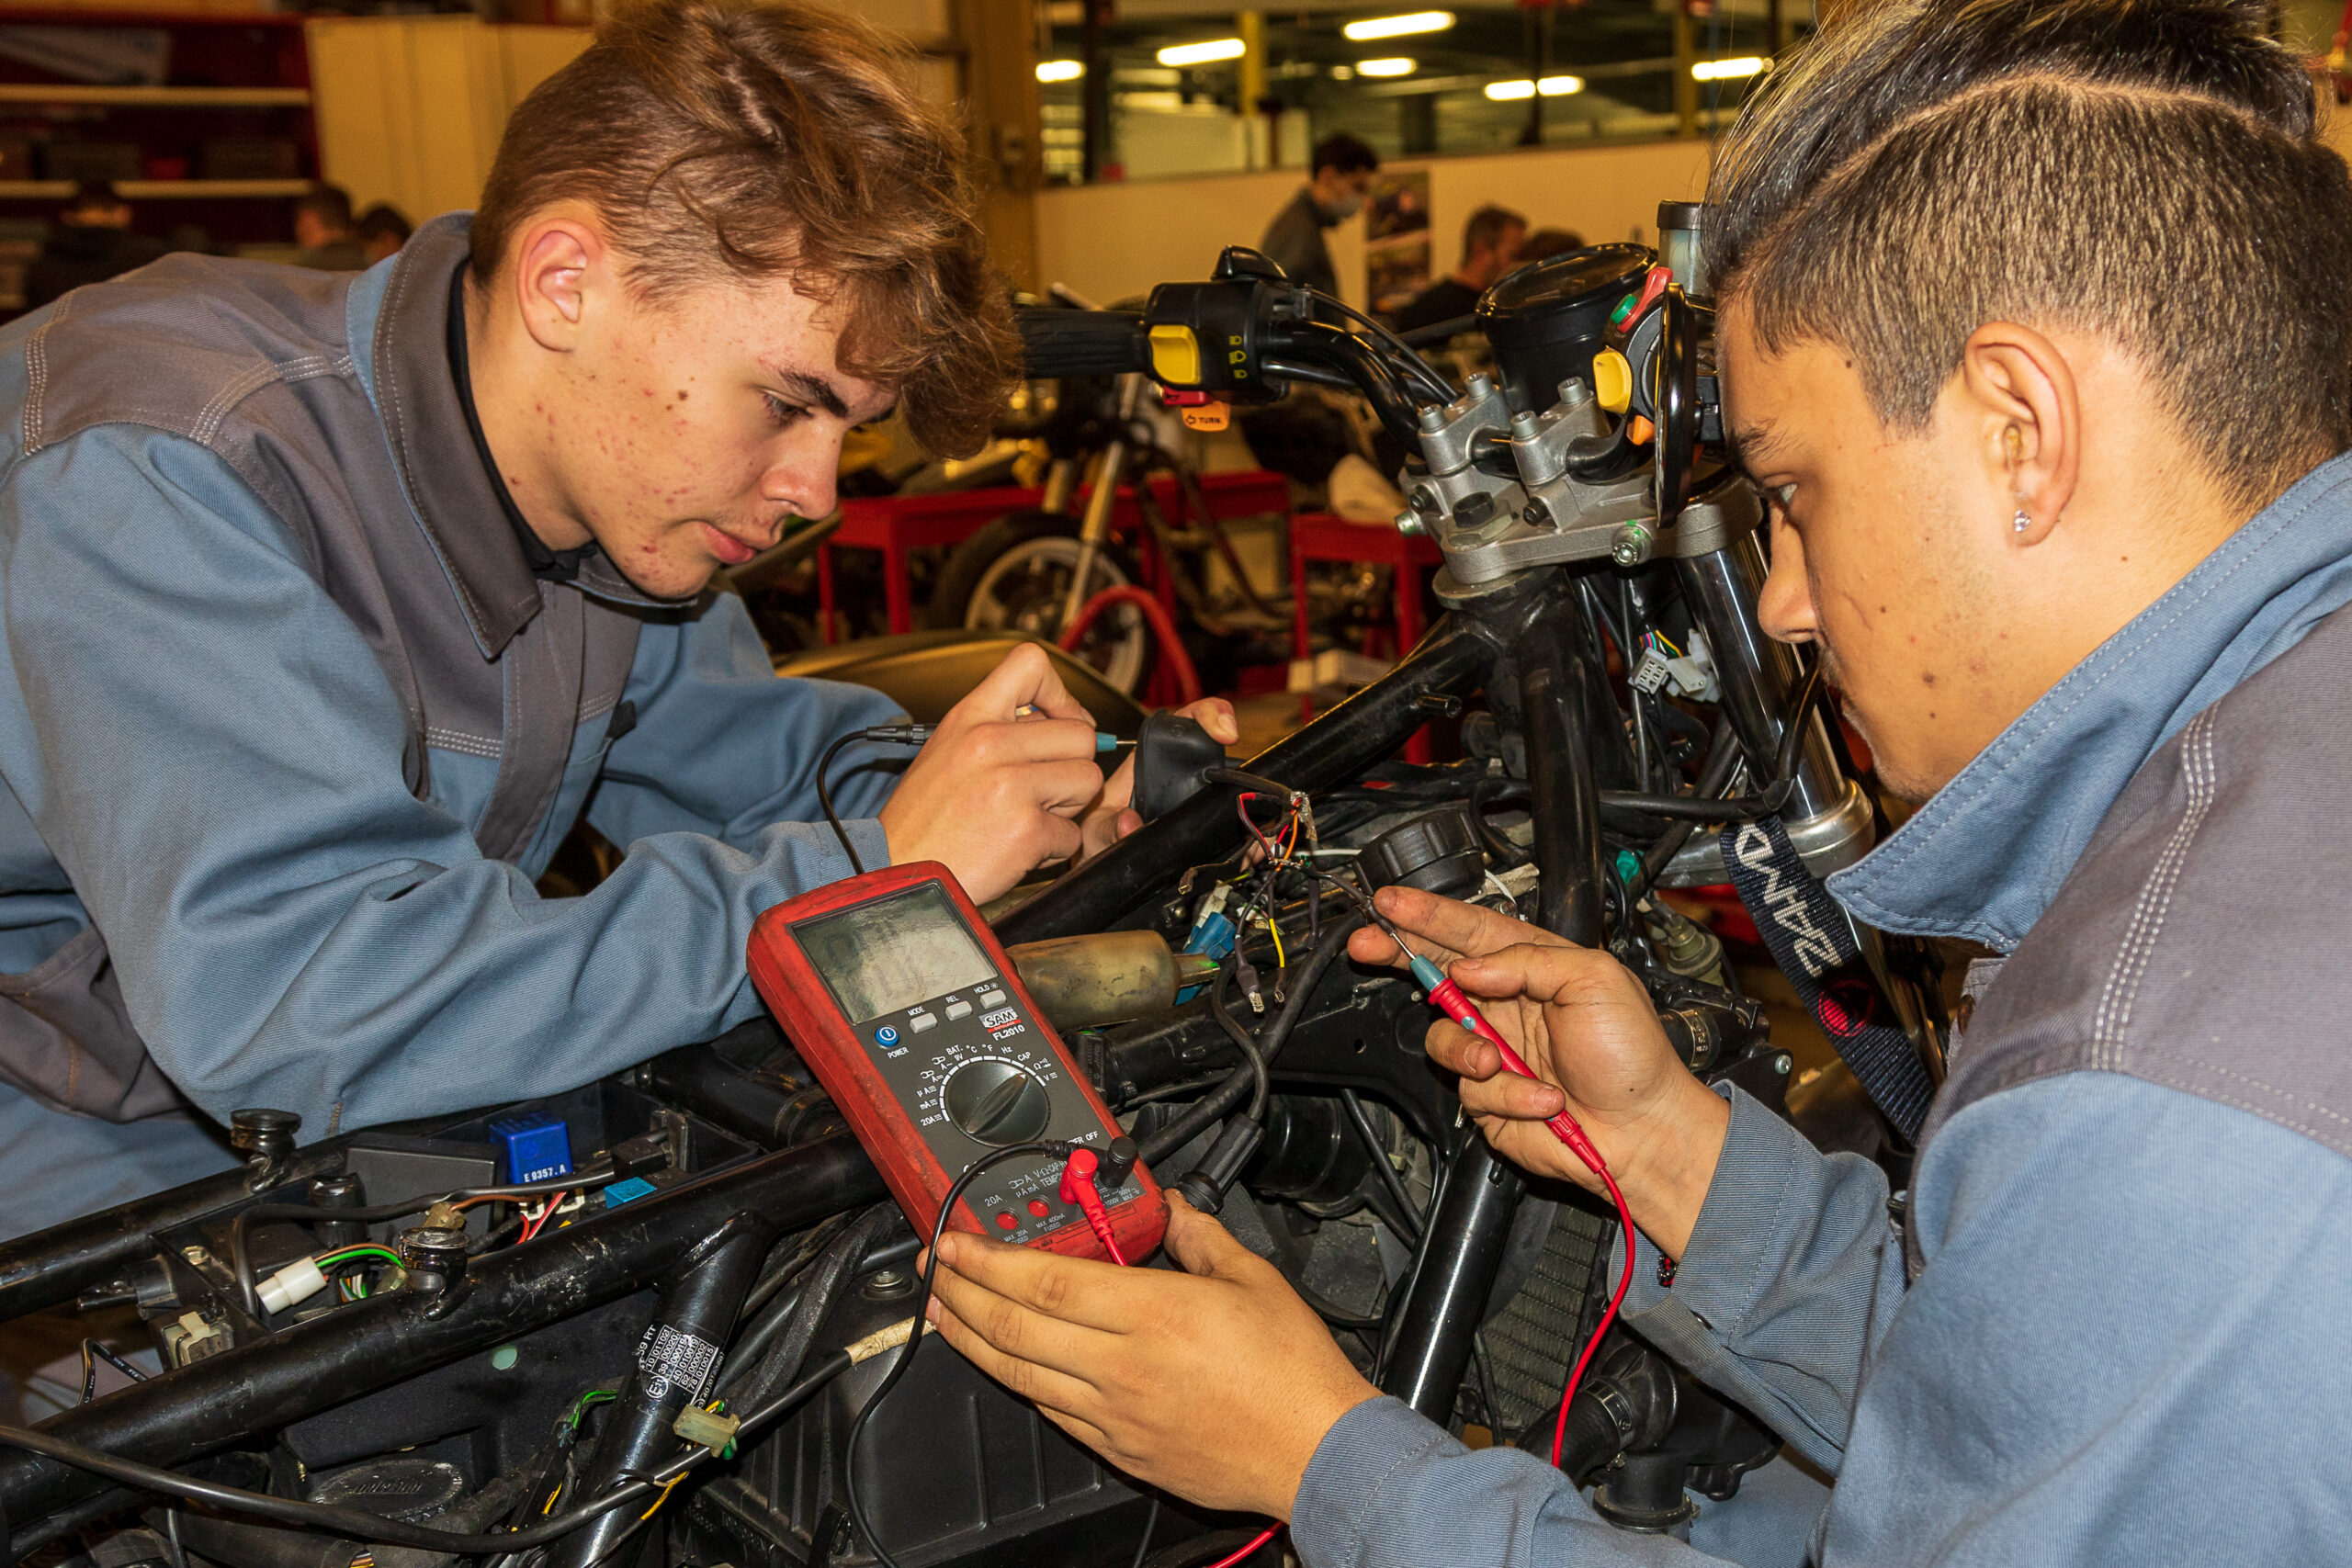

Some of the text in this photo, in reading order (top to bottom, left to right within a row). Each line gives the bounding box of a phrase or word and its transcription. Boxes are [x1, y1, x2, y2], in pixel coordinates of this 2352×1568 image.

[1198, 416, 1221, 424] TURN
[974, 984, 990, 994] HOLD
[945, 995, 959, 1003] REL
[908, 1006, 925, 1017] MODE
[985, 1010, 1016, 1027] SAM
[992, 1024, 1025, 1041] FL2010
[887, 1046, 909, 1059] POWER
[1001, 1045, 1013, 1055] Hz
[954, 1053, 964, 1061] 9V
[1017, 1051, 1031, 1062] CAP
[1085, 1131, 1099, 1141] OFF
[524, 1173, 530, 1183] E
[984, 1194, 1003, 1207] 20A
[1016, 1228, 1028, 1237] 20A
[1044, 1222, 1061, 1233] FUSED
[643, 1324, 657, 1341] RT
[646, 1357, 656, 1369] 10
[658, 1362, 669, 1375] 39
[681, 1342, 707, 1385] 62 000002
[688, 1347, 714, 1390] 78 010015
[673, 1369, 683, 1382] 40
